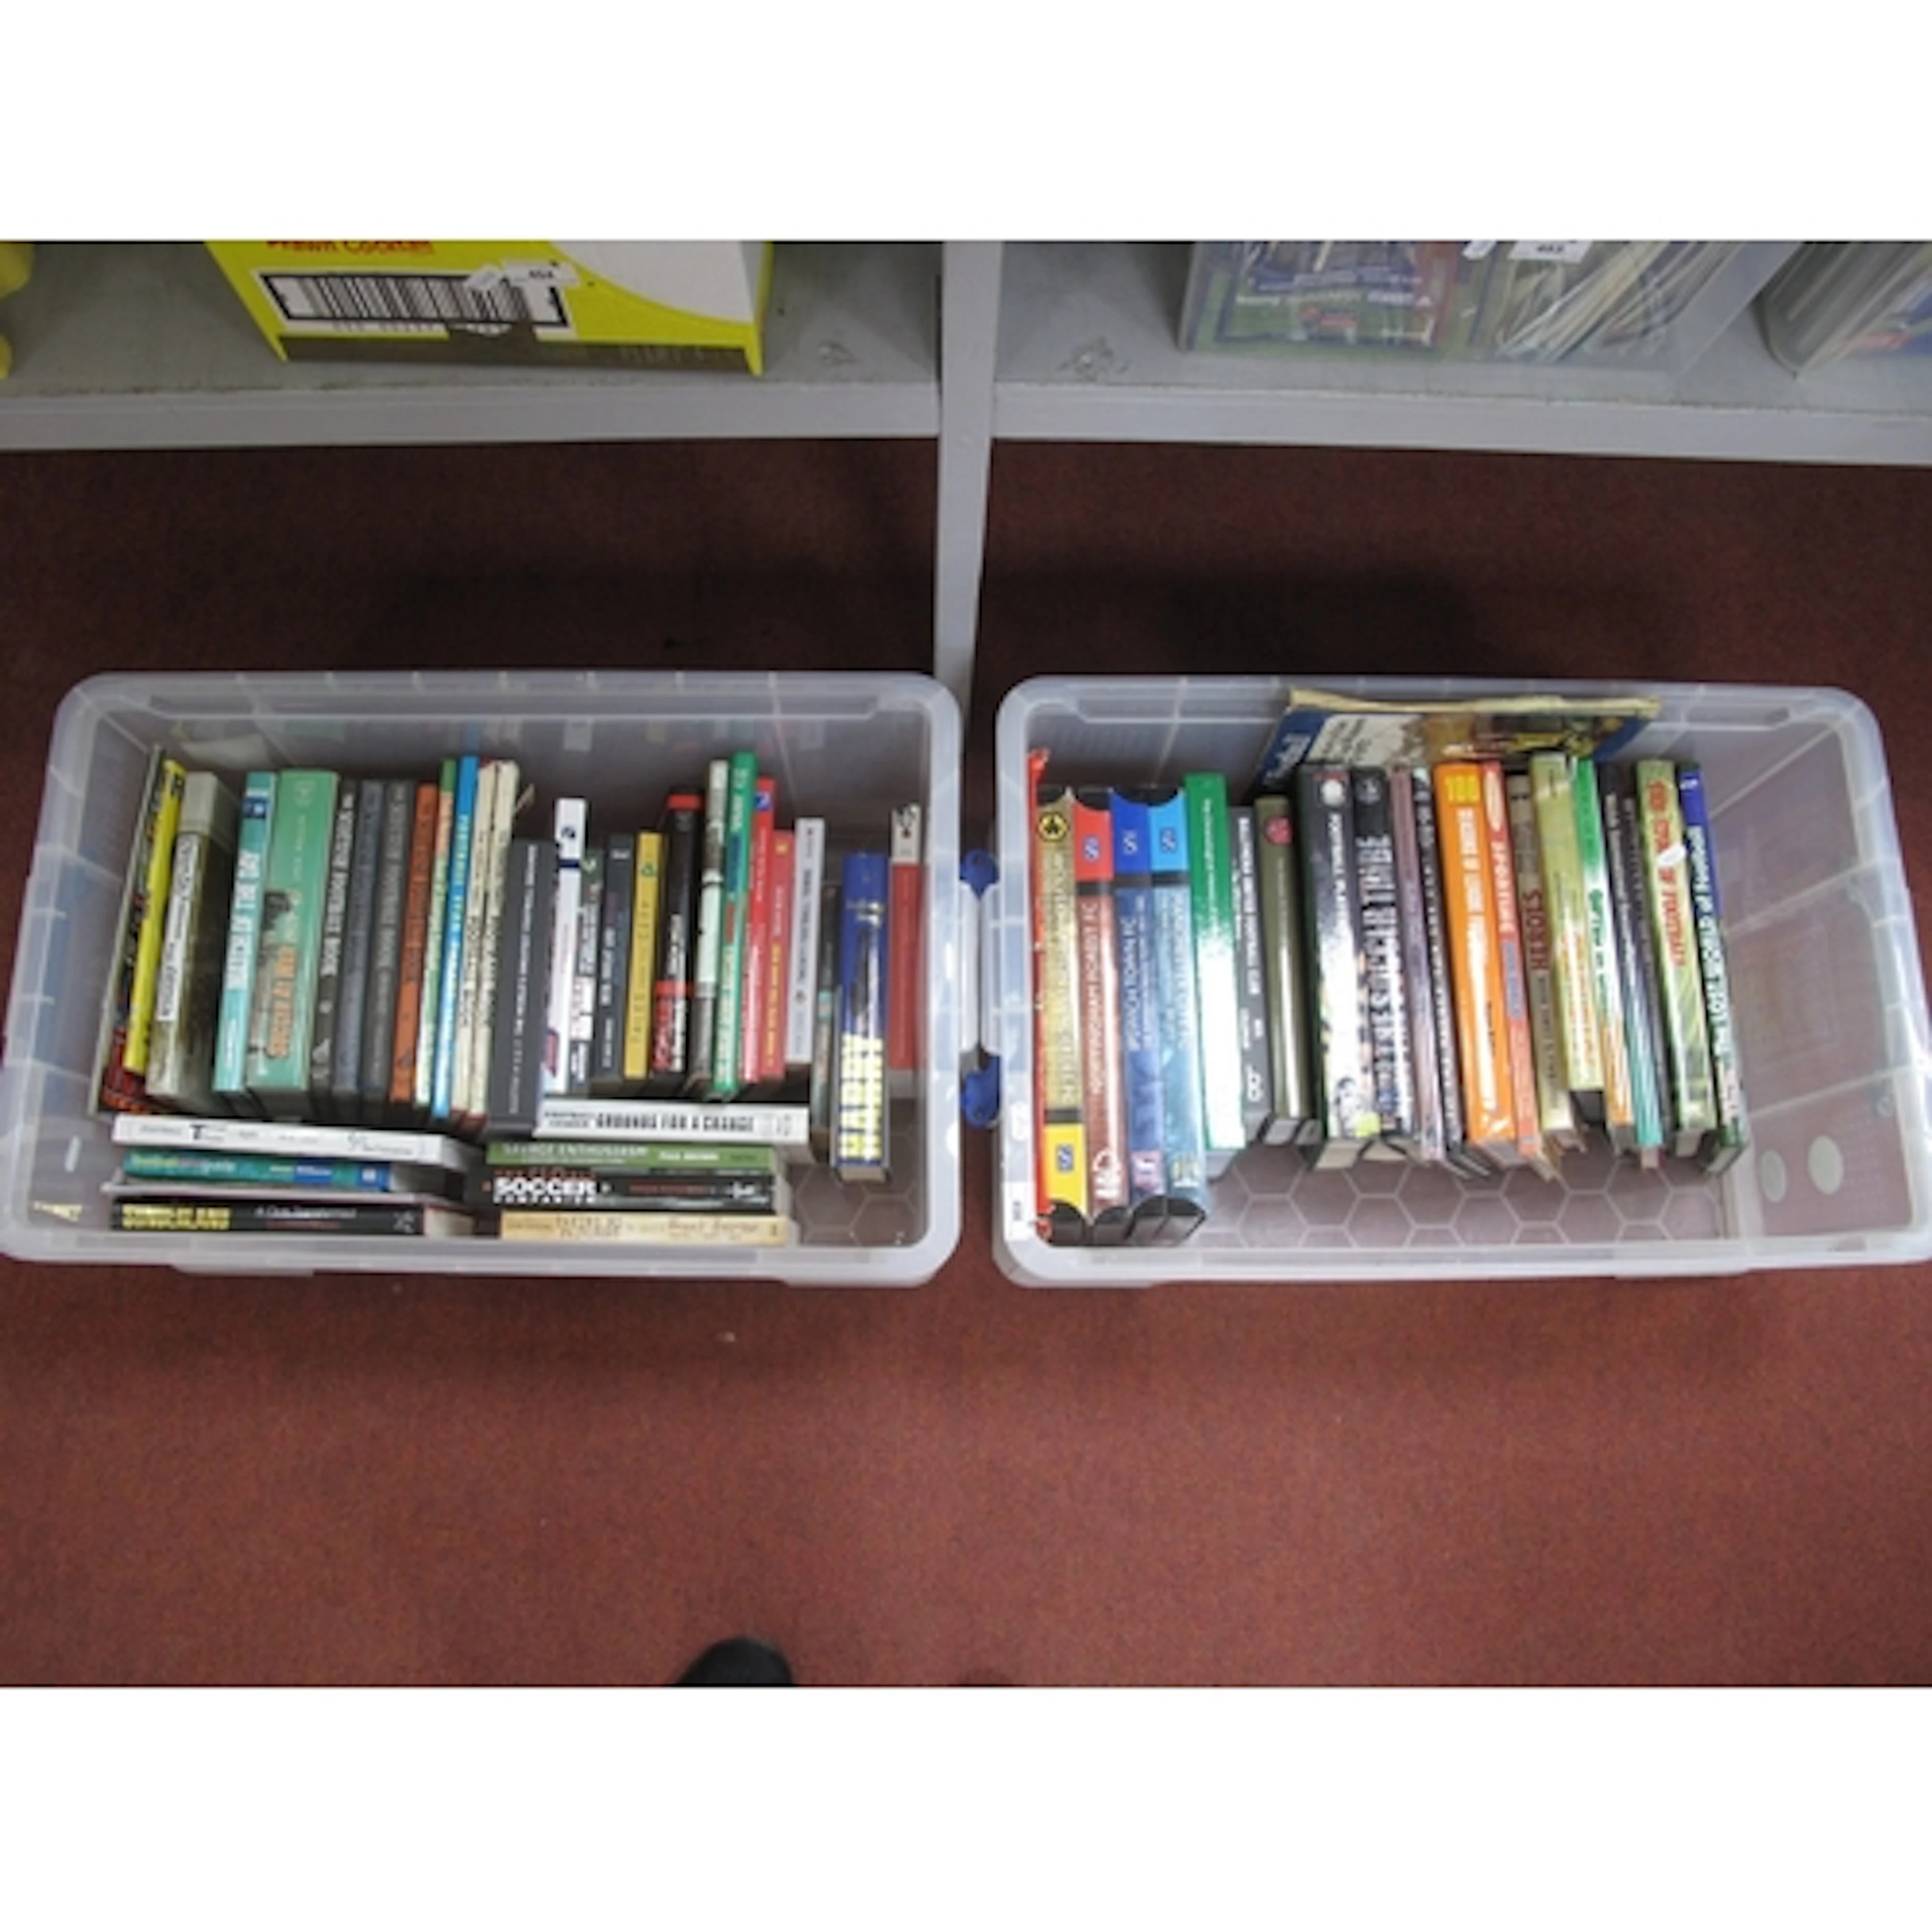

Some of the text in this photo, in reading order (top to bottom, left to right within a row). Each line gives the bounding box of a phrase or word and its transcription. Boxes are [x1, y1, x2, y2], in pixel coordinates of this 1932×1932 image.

[237, 849, 261, 879] DAY
[1327, 813, 1345, 874] FOOTBALL
[234, 880, 258, 910] THE
[325, 871, 347, 932] FOOTBALL
[379, 865, 399, 926] FOOTBALL
[232, 915, 255, 930] OF
[1243, 915, 1259, 967] FOOTBALL
[1522, 888, 1550, 971] HEROES
[226, 930, 253, 991] MATCH
[320, 936, 341, 978] BOOK
[376, 929, 395, 970] BOOK
[1083, 902, 1106, 1094] NOTTINGHAM FOREST FC
[1120, 916, 1142, 1051] IPSWICH TOWN FC
[1247, 969, 1261, 994] CLUB
[661, 1114, 688, 1130] FOR
[692, 1115, 699, 1131] A
[703, 1115, 754, 1132] CHANGE
[556, 1144, 649, 1159] ENTHUSIASM
[494, 1176, 595, 1195] SOCCER
